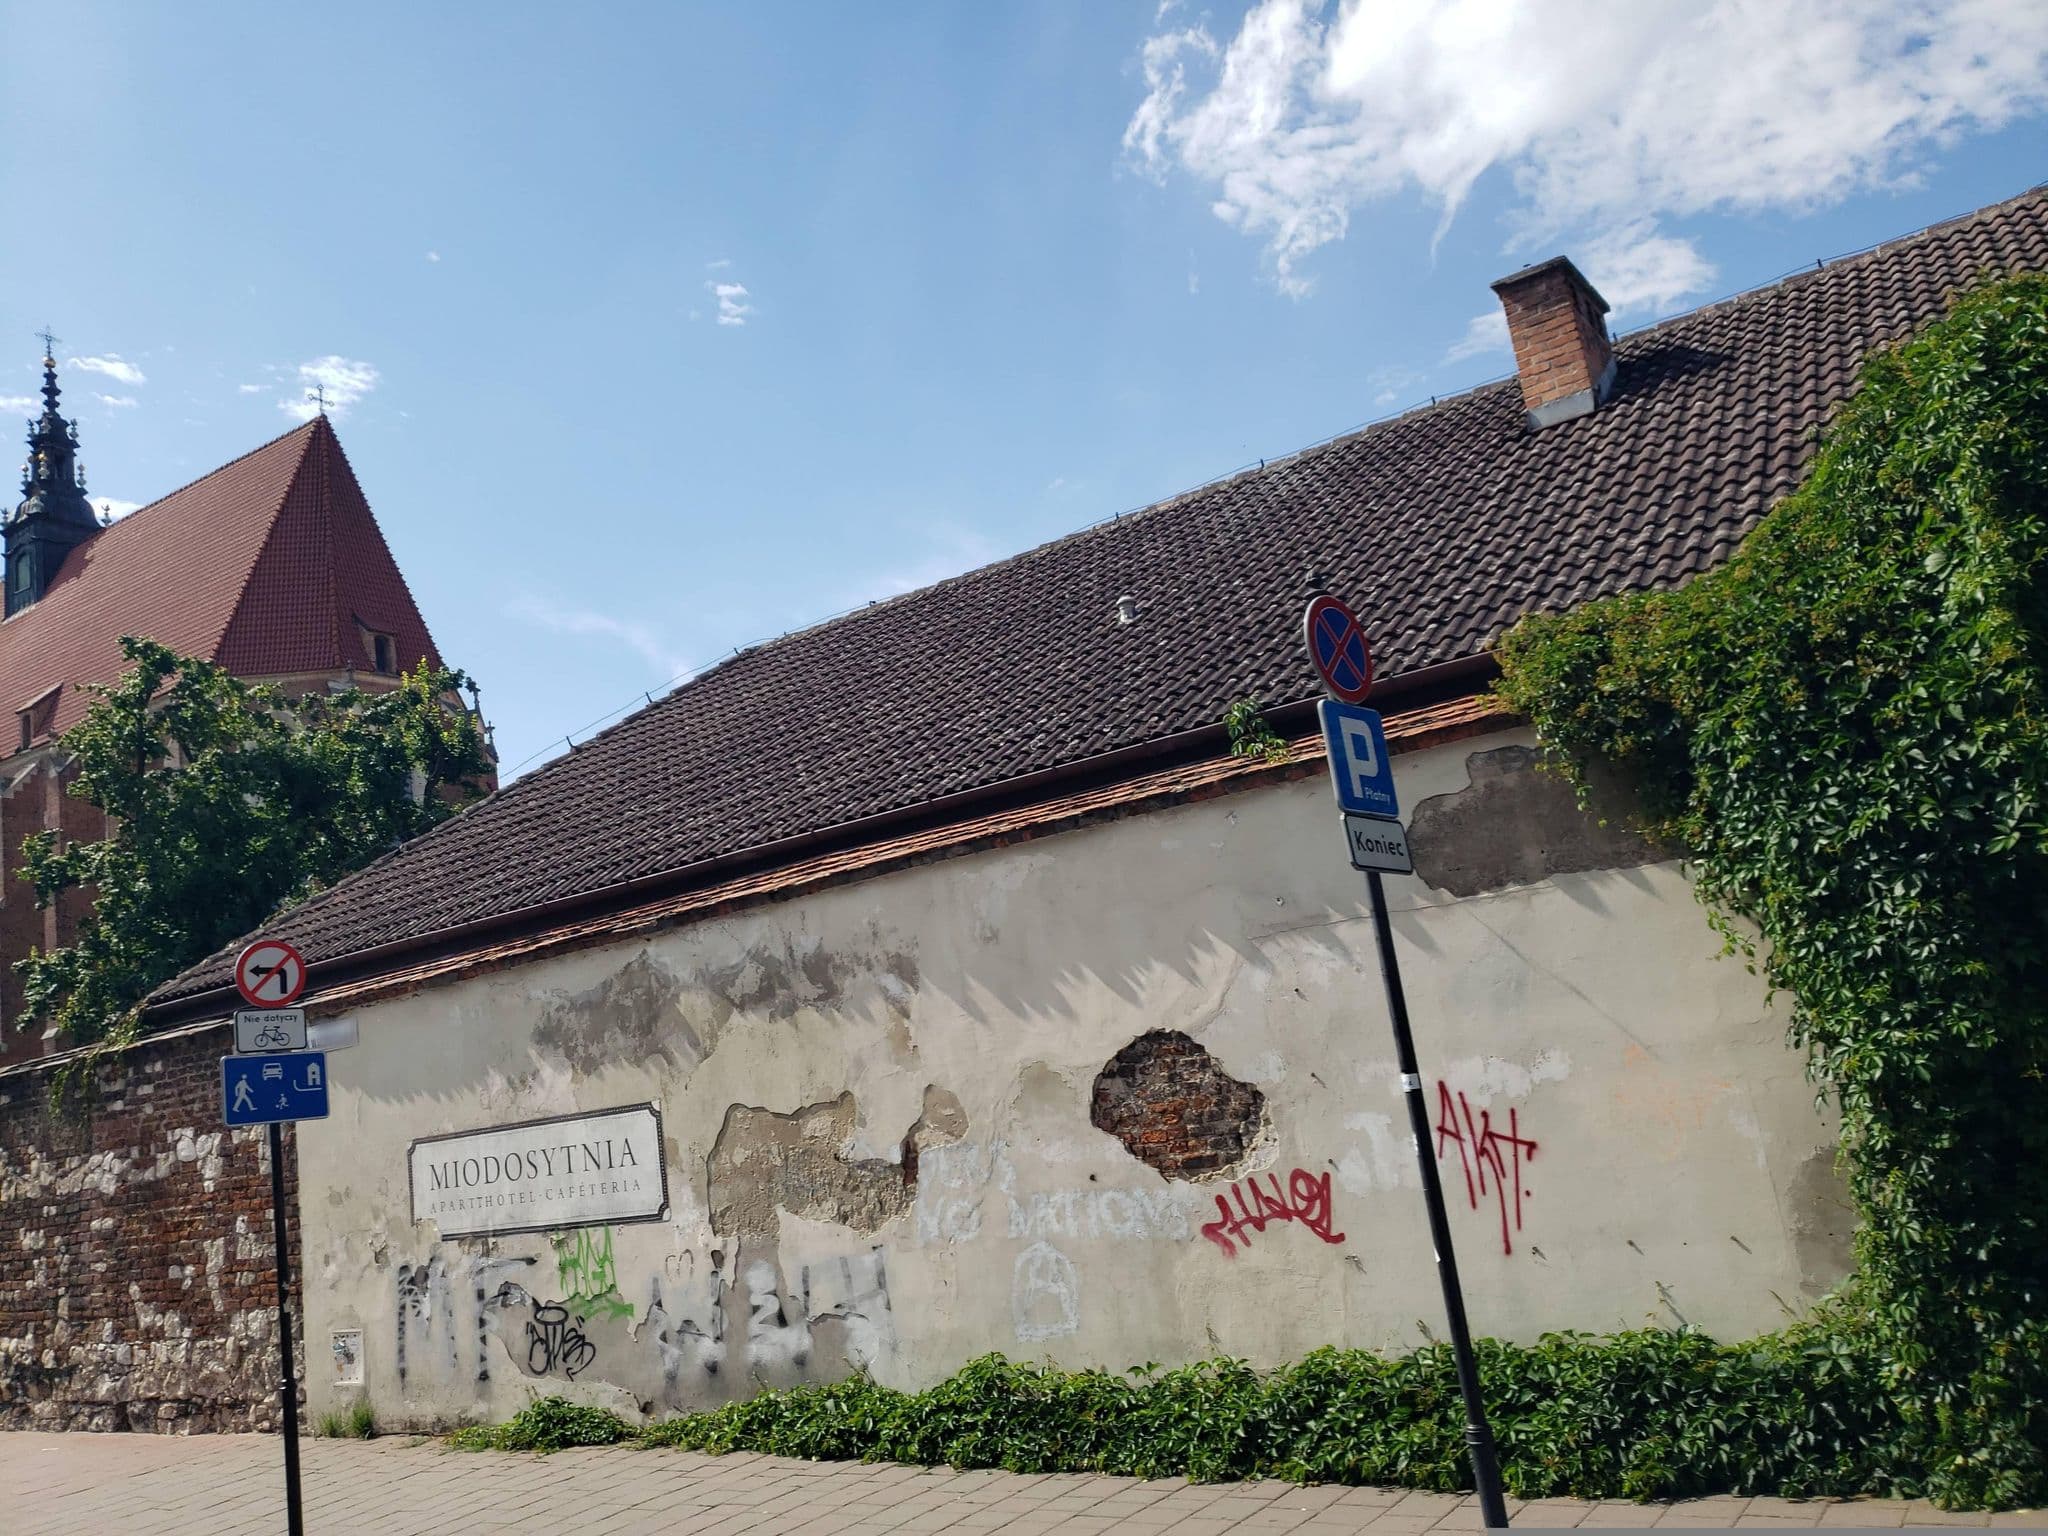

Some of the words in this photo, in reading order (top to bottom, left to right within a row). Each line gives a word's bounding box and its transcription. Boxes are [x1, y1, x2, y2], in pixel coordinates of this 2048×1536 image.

[1338, 716, 1379, 798] P
[1353, 830, 1405, 857] Koniec
[244, 1015, 260, 1023] Nie
[264, 1014, 298, 1023] dotyczy
[428, 1137, 639, 1191] MIODOSYTNIA
